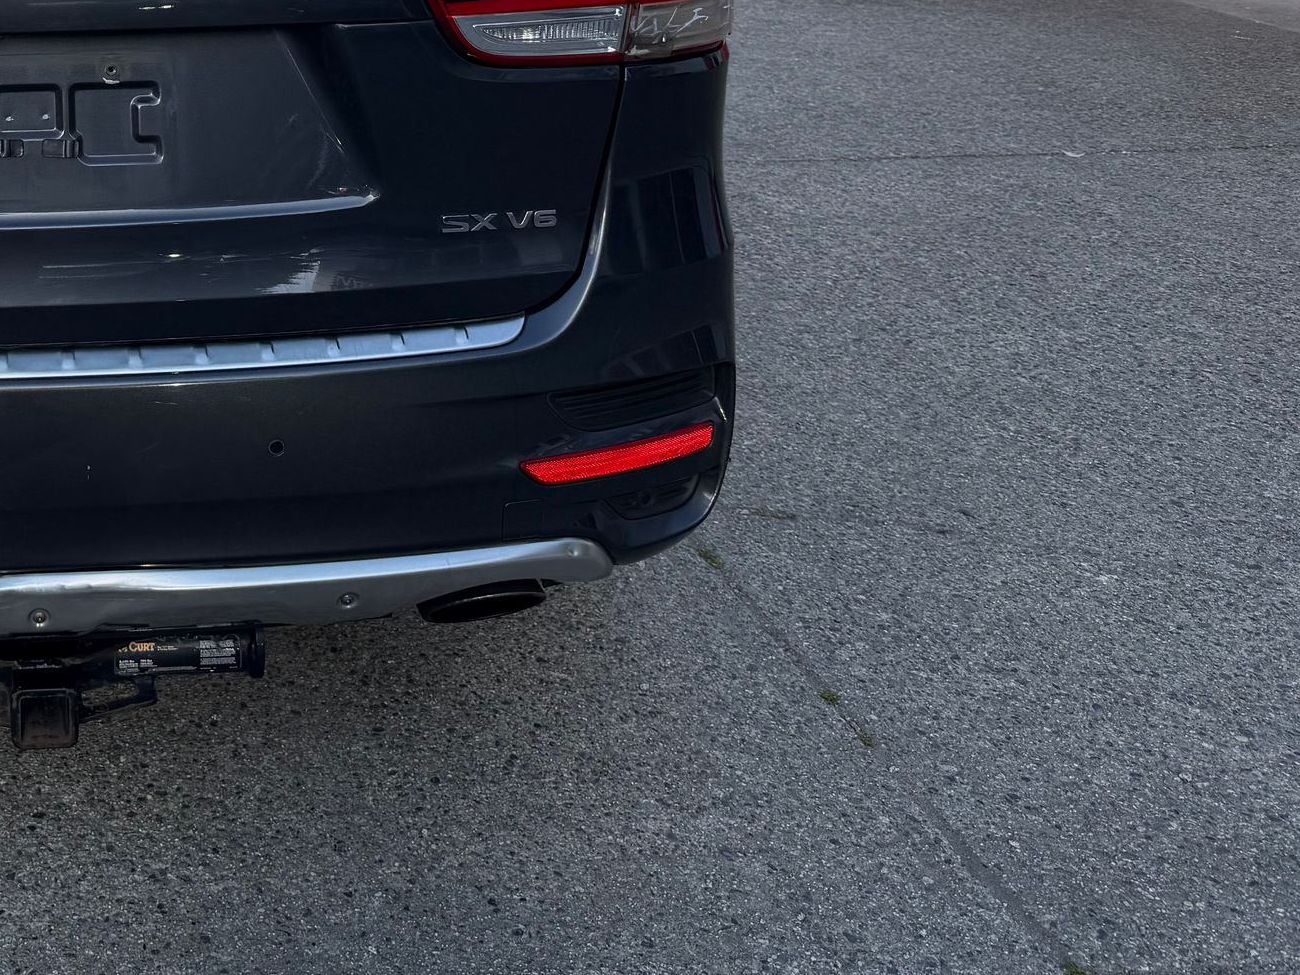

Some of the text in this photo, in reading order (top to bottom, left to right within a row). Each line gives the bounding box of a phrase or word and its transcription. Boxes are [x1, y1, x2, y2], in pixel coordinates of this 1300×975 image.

[442, 209, 557, 233] SX V6
[128, 641, 156, 653] CURT
